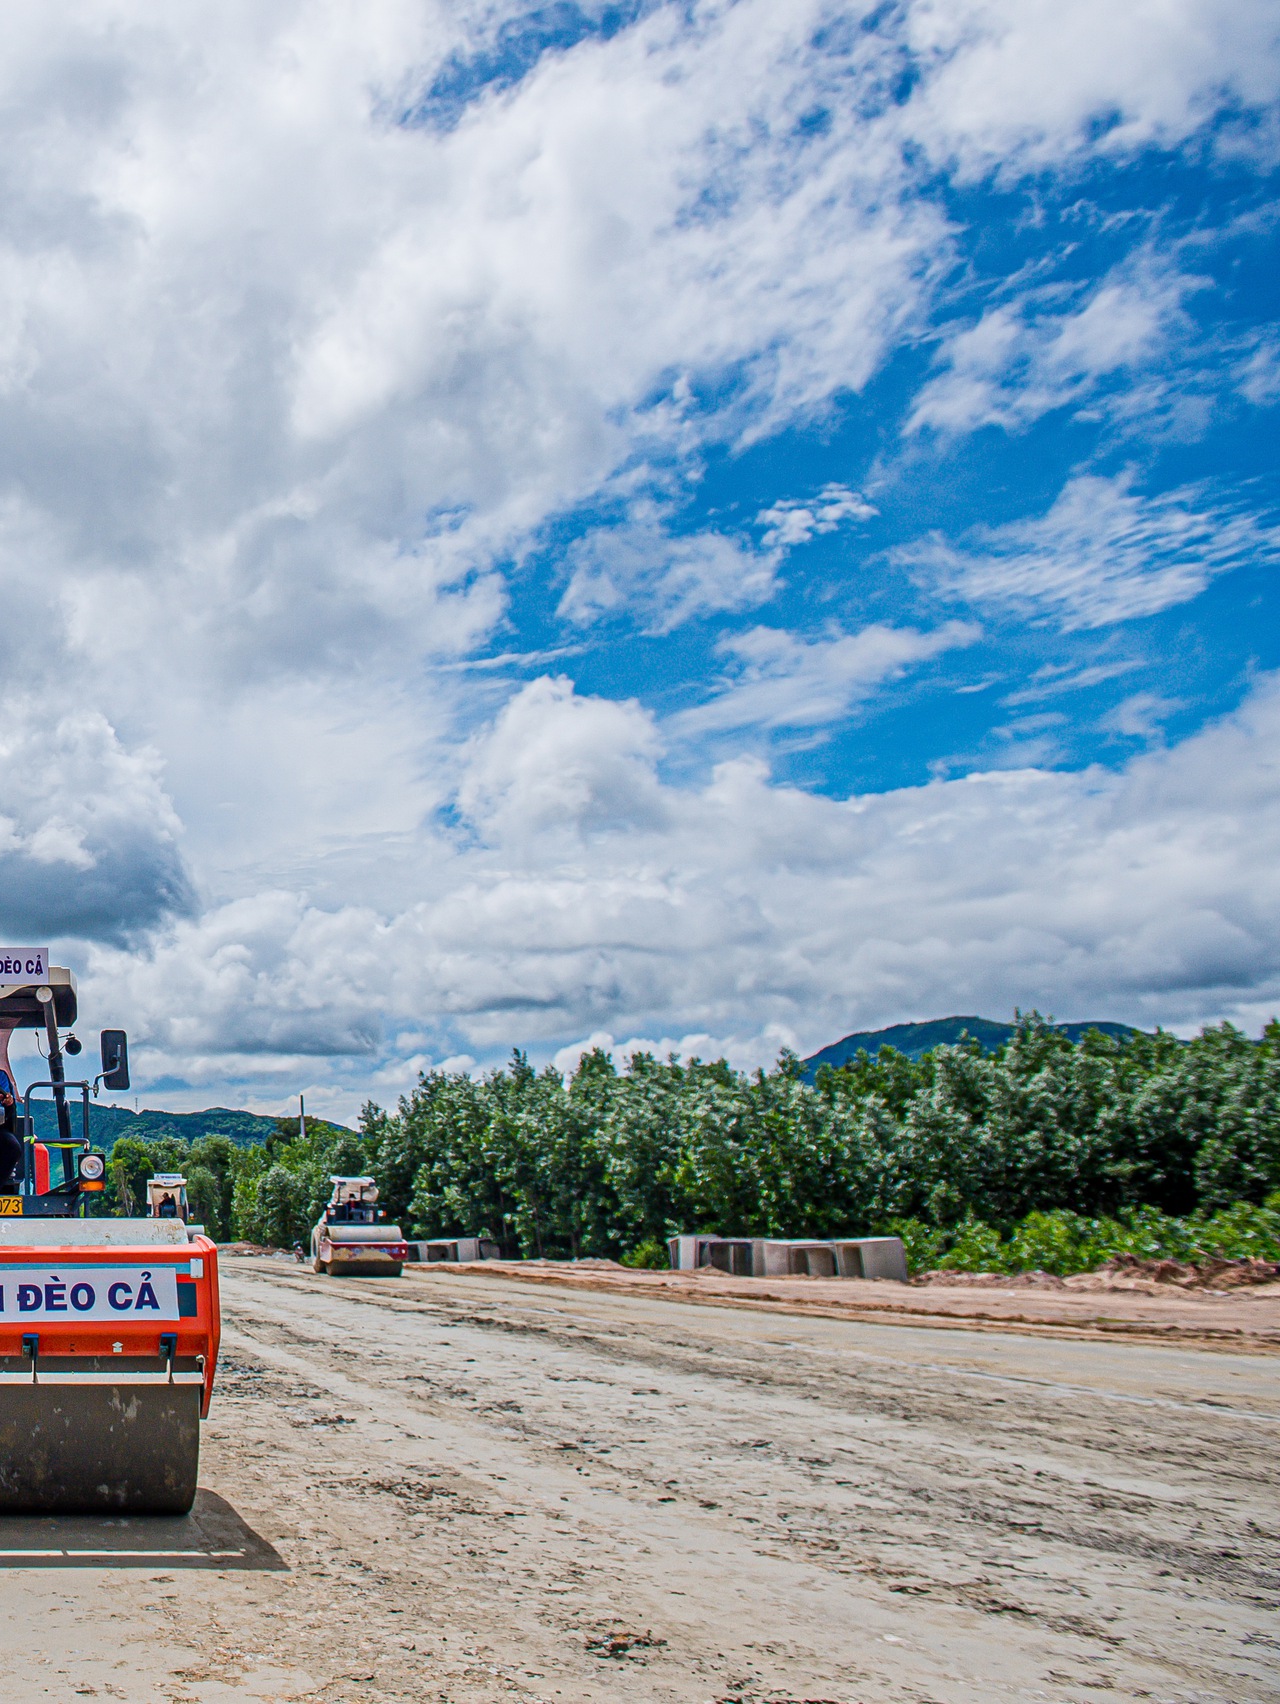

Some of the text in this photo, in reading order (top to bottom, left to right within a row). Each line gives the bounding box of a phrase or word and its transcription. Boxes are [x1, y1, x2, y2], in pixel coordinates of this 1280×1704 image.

[25, 954, 43, 974] CẢ
[17, 1275, 96, 1312] ĐÈO
[107, 1271, 161, 1311] CẢ
